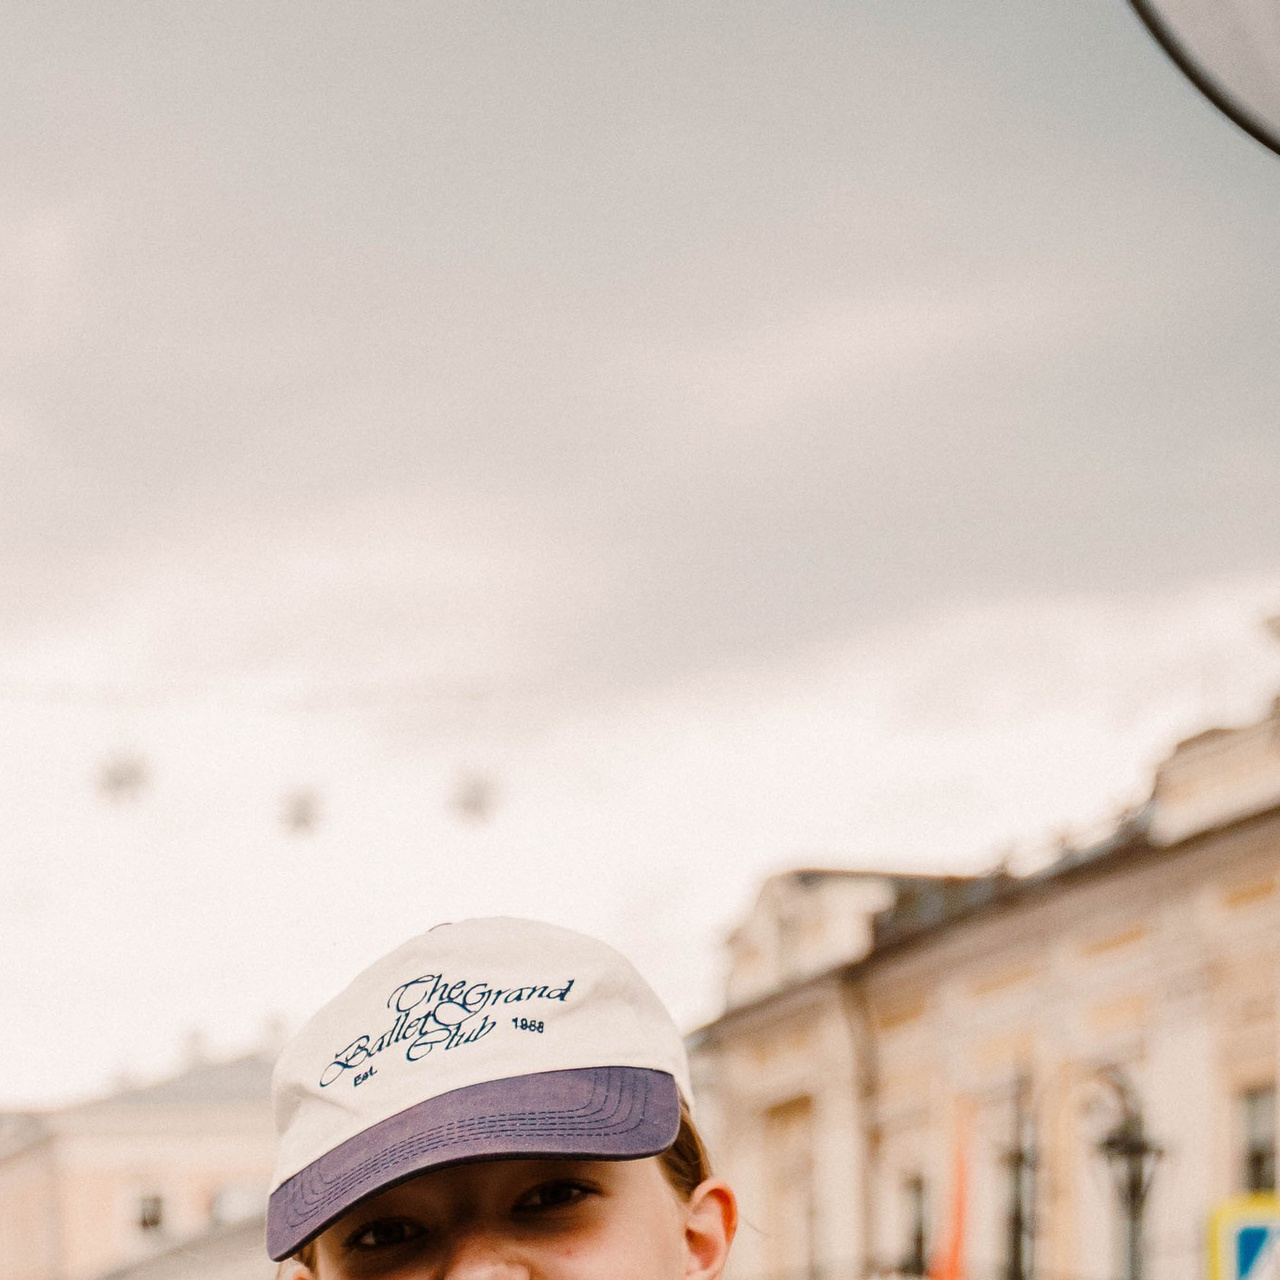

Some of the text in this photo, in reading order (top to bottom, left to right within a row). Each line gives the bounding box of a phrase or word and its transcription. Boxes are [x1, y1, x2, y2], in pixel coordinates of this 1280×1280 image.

[387, 973, 574, 1027] The Grand
[320, 1011, 435, 1087] Ballet
[406, 1015, 496, 1061] Club
